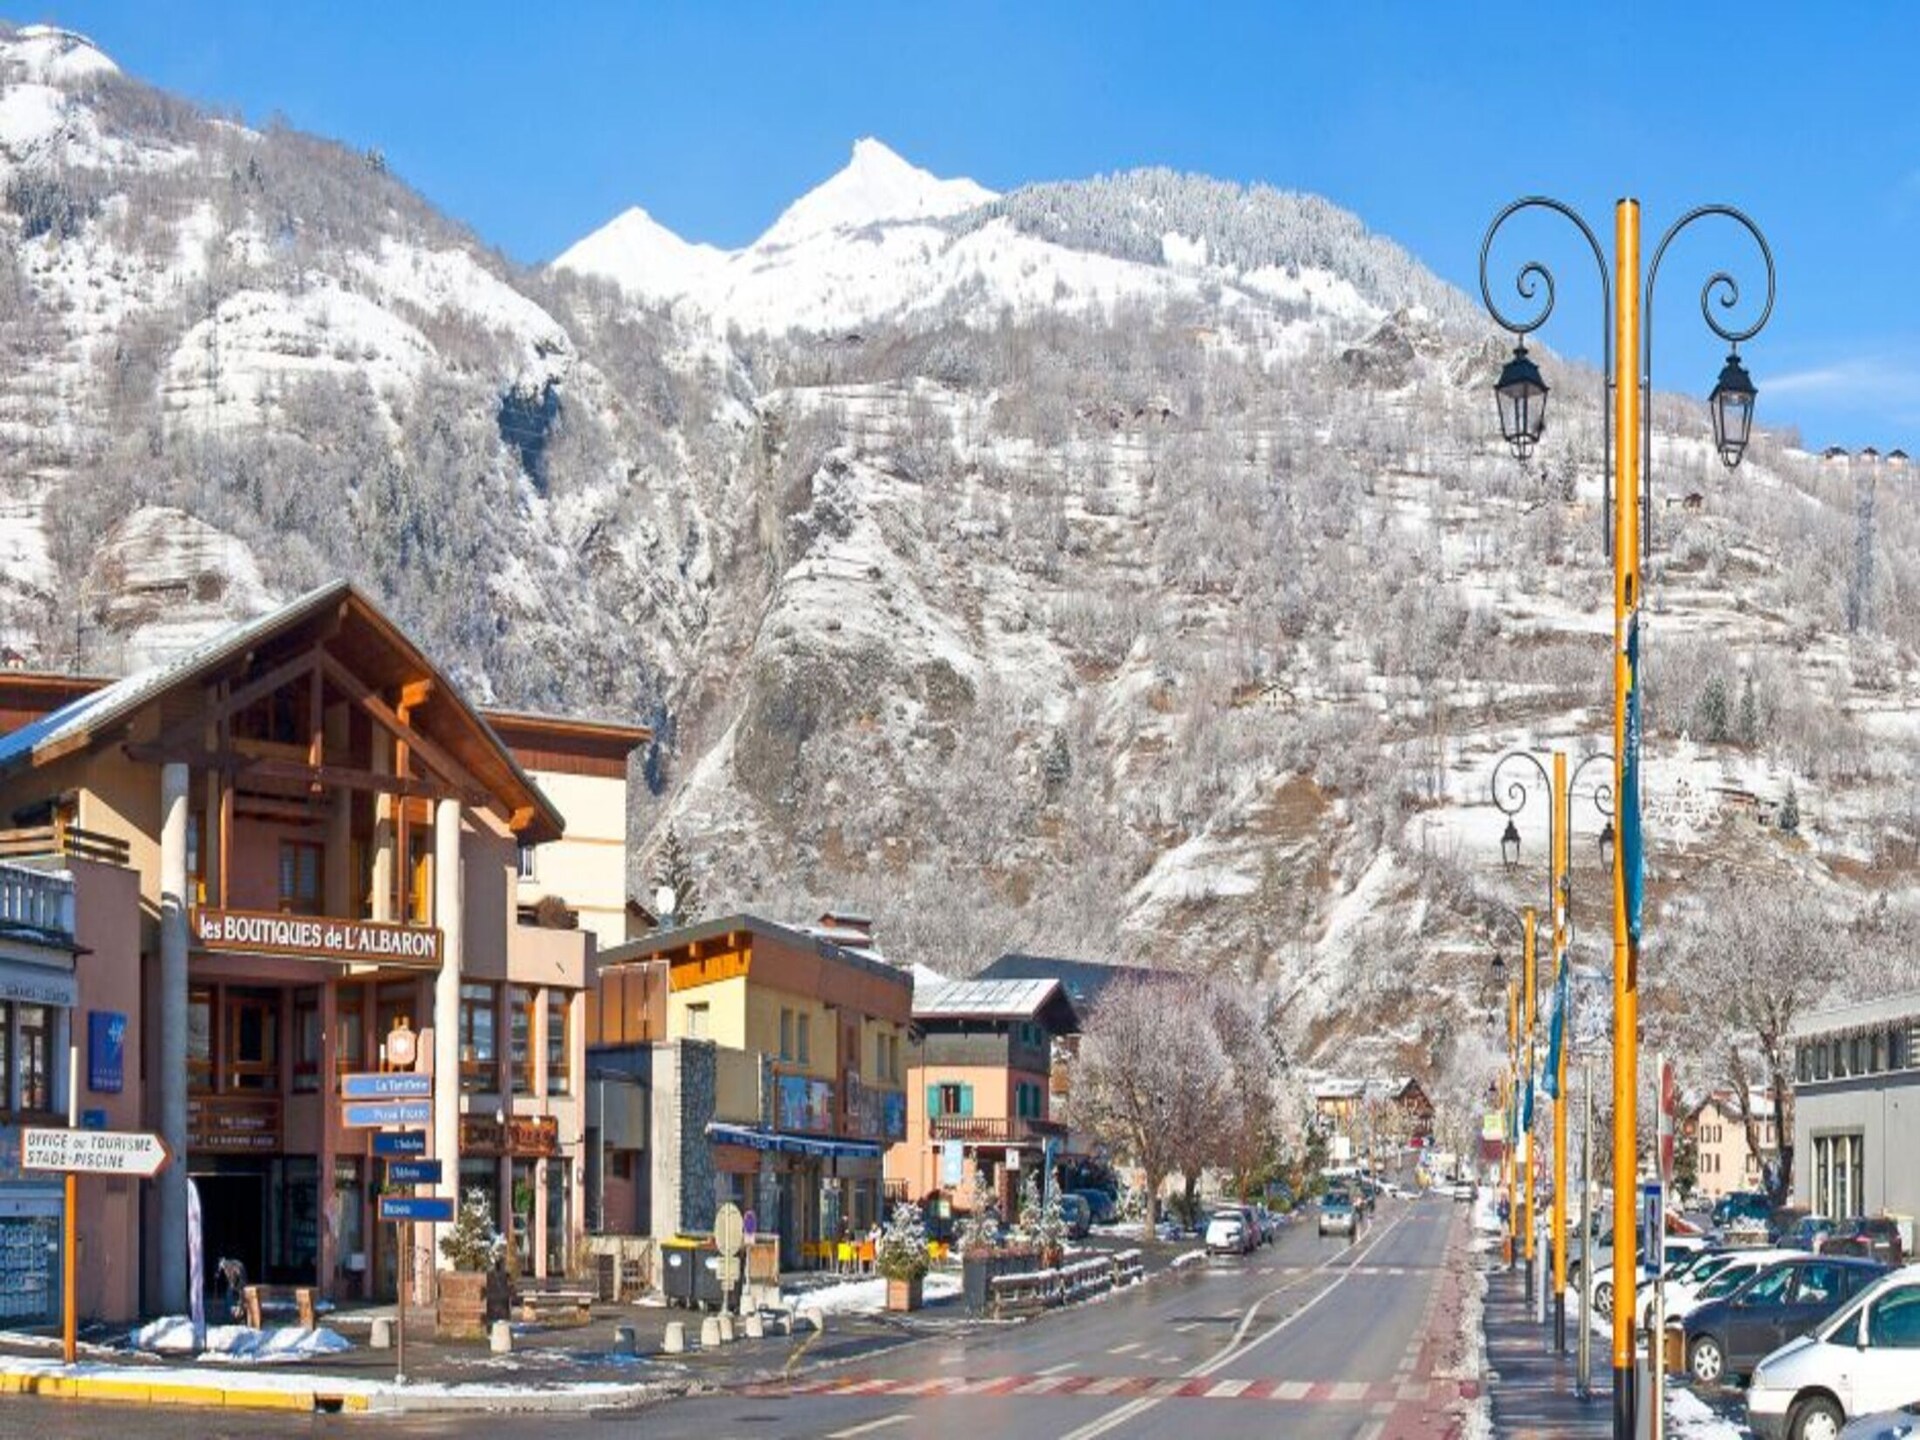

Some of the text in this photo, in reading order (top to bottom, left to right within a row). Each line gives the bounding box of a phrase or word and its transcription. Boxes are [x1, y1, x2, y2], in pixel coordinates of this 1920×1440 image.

[200, 913, 436, 957] les BOUTIQUES de L'ALBARON
[28, 1133, 68, 1148] OFFICE
[91, 1136, 151, 1151] TOURISME
